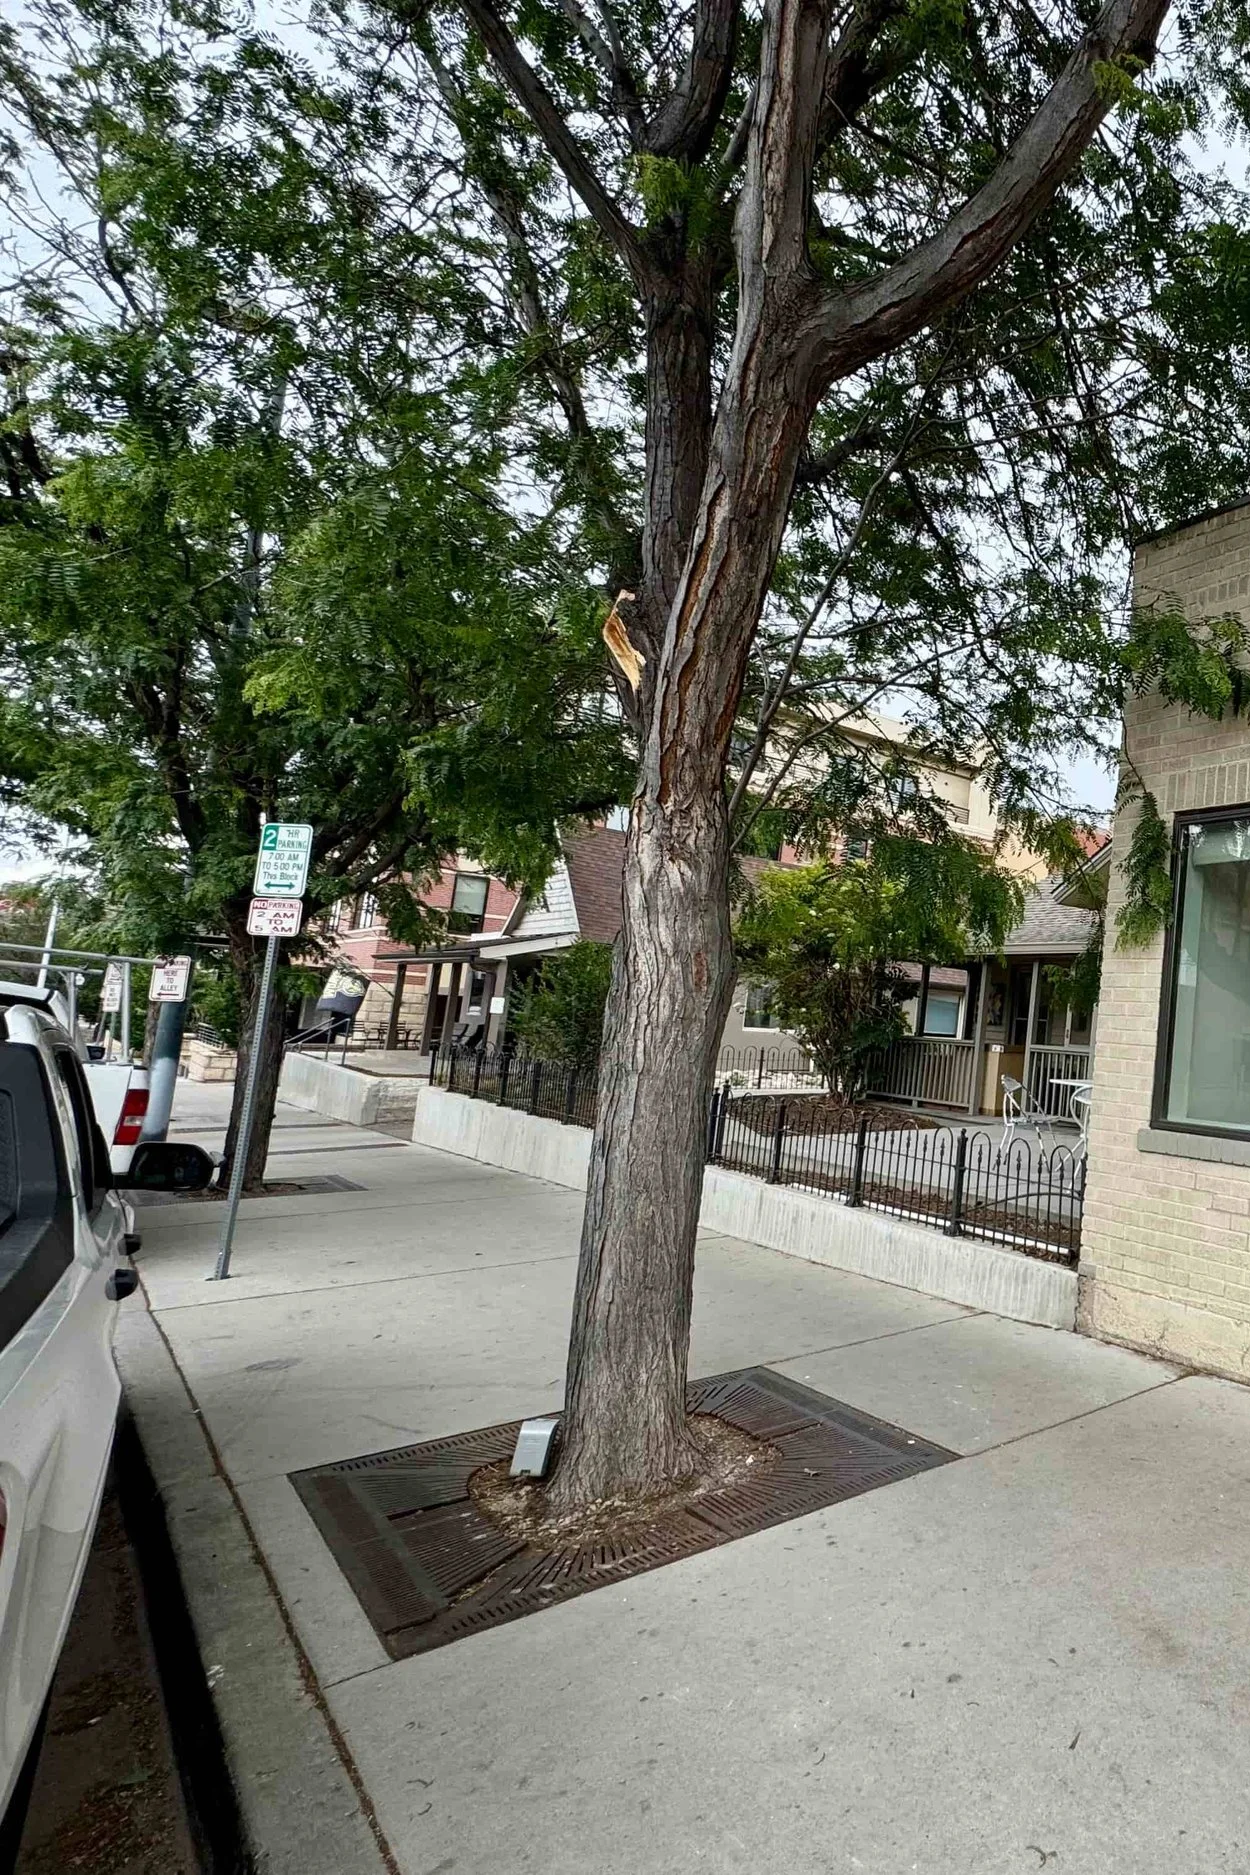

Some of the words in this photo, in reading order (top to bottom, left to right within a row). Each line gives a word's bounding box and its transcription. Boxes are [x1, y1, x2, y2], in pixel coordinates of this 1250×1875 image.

[263, 829, 276, 847] 2
[287, 829, 300, 838] HR
[278, 840, 307, 850] PARKING
[268, 852, 285, 860] 700
[286, 853, 300, 861] AM
[262, 862, 271, 870] TO
[273, 862, 290, 870] 500
[291, 863, 304, 871] PM
[263, 871, 277, 880] This
[279, 872, 299, 881] Block
[254, 901, 267, 909] NO
[268, 901, 299, 909] PARKING
